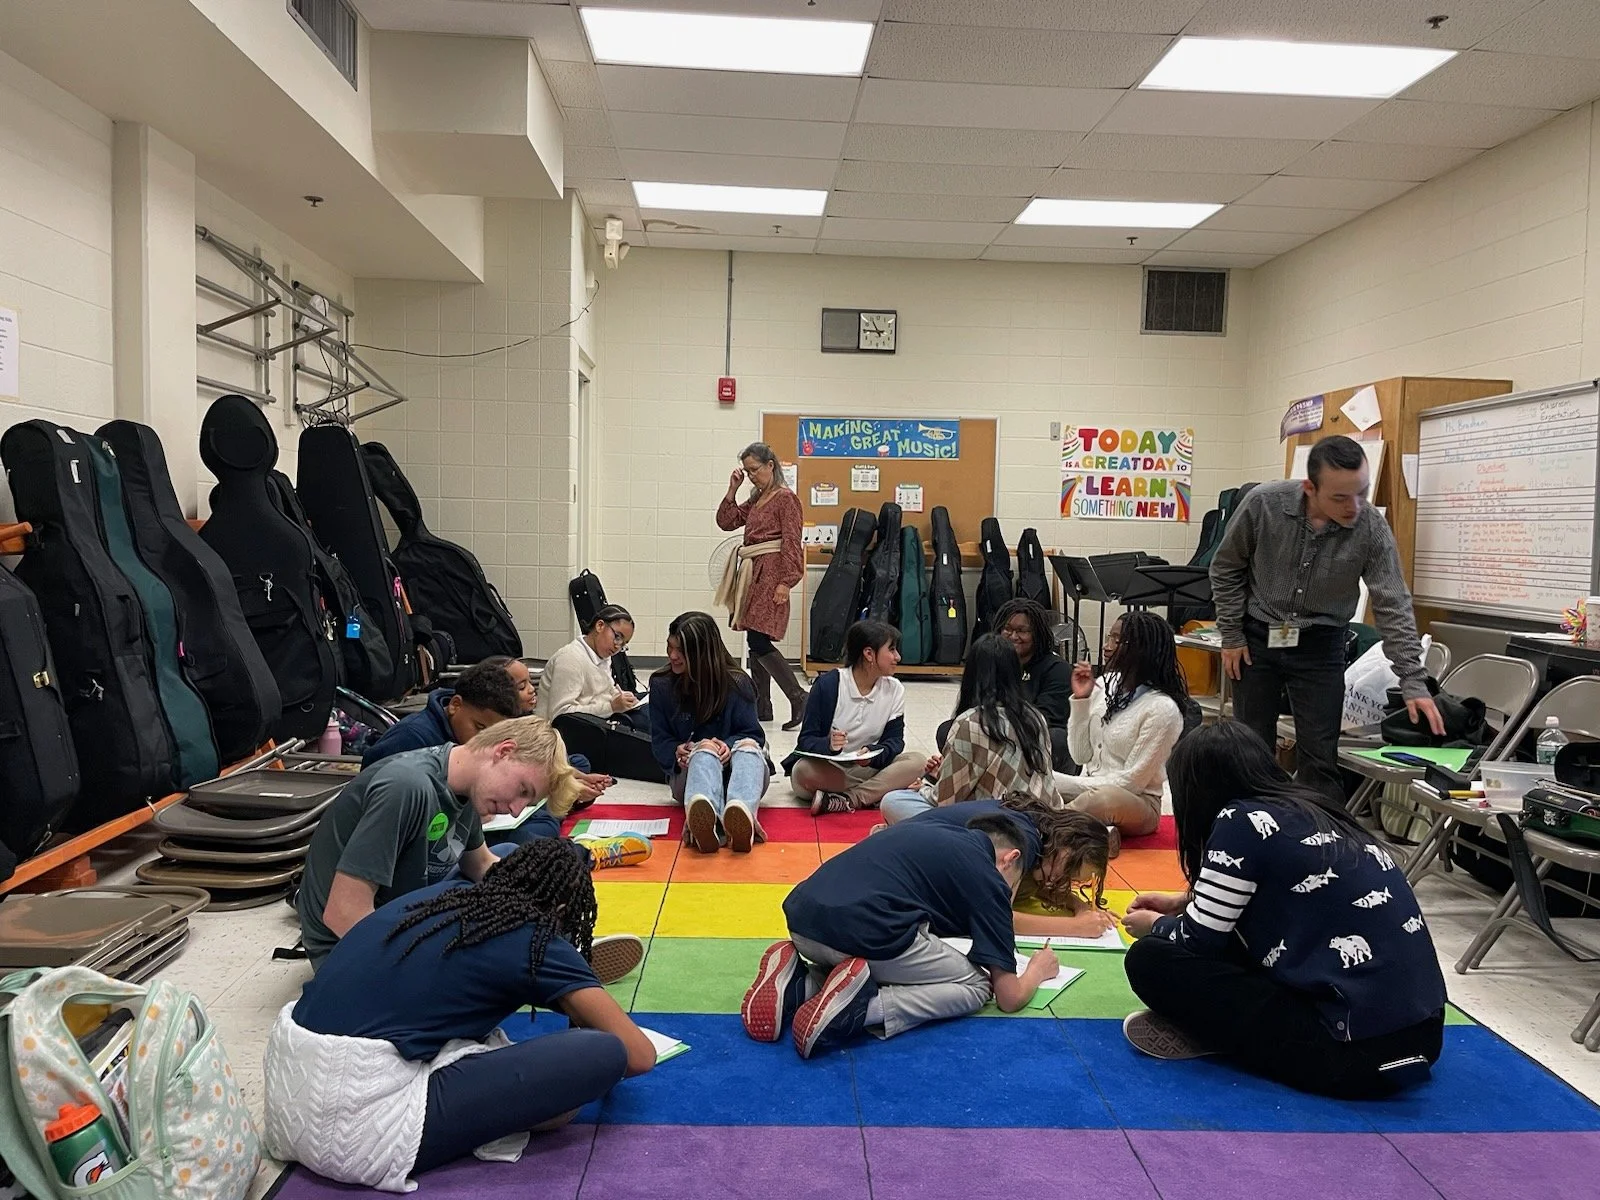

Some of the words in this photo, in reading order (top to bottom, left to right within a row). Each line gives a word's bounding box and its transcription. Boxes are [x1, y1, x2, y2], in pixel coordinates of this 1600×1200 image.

[851, 429, 900, 451] GREAT
[1078, 428, 1177, 454] TODAY
[1082, 456, 1141, 471] GREAT
[1143, 457, 1177, 471] DAY
[1085, 475, 1167, 498] LEARN
[1073, 499, 1133, 517] SOMETHING
[1136, 501, 1176, 519] NEW
